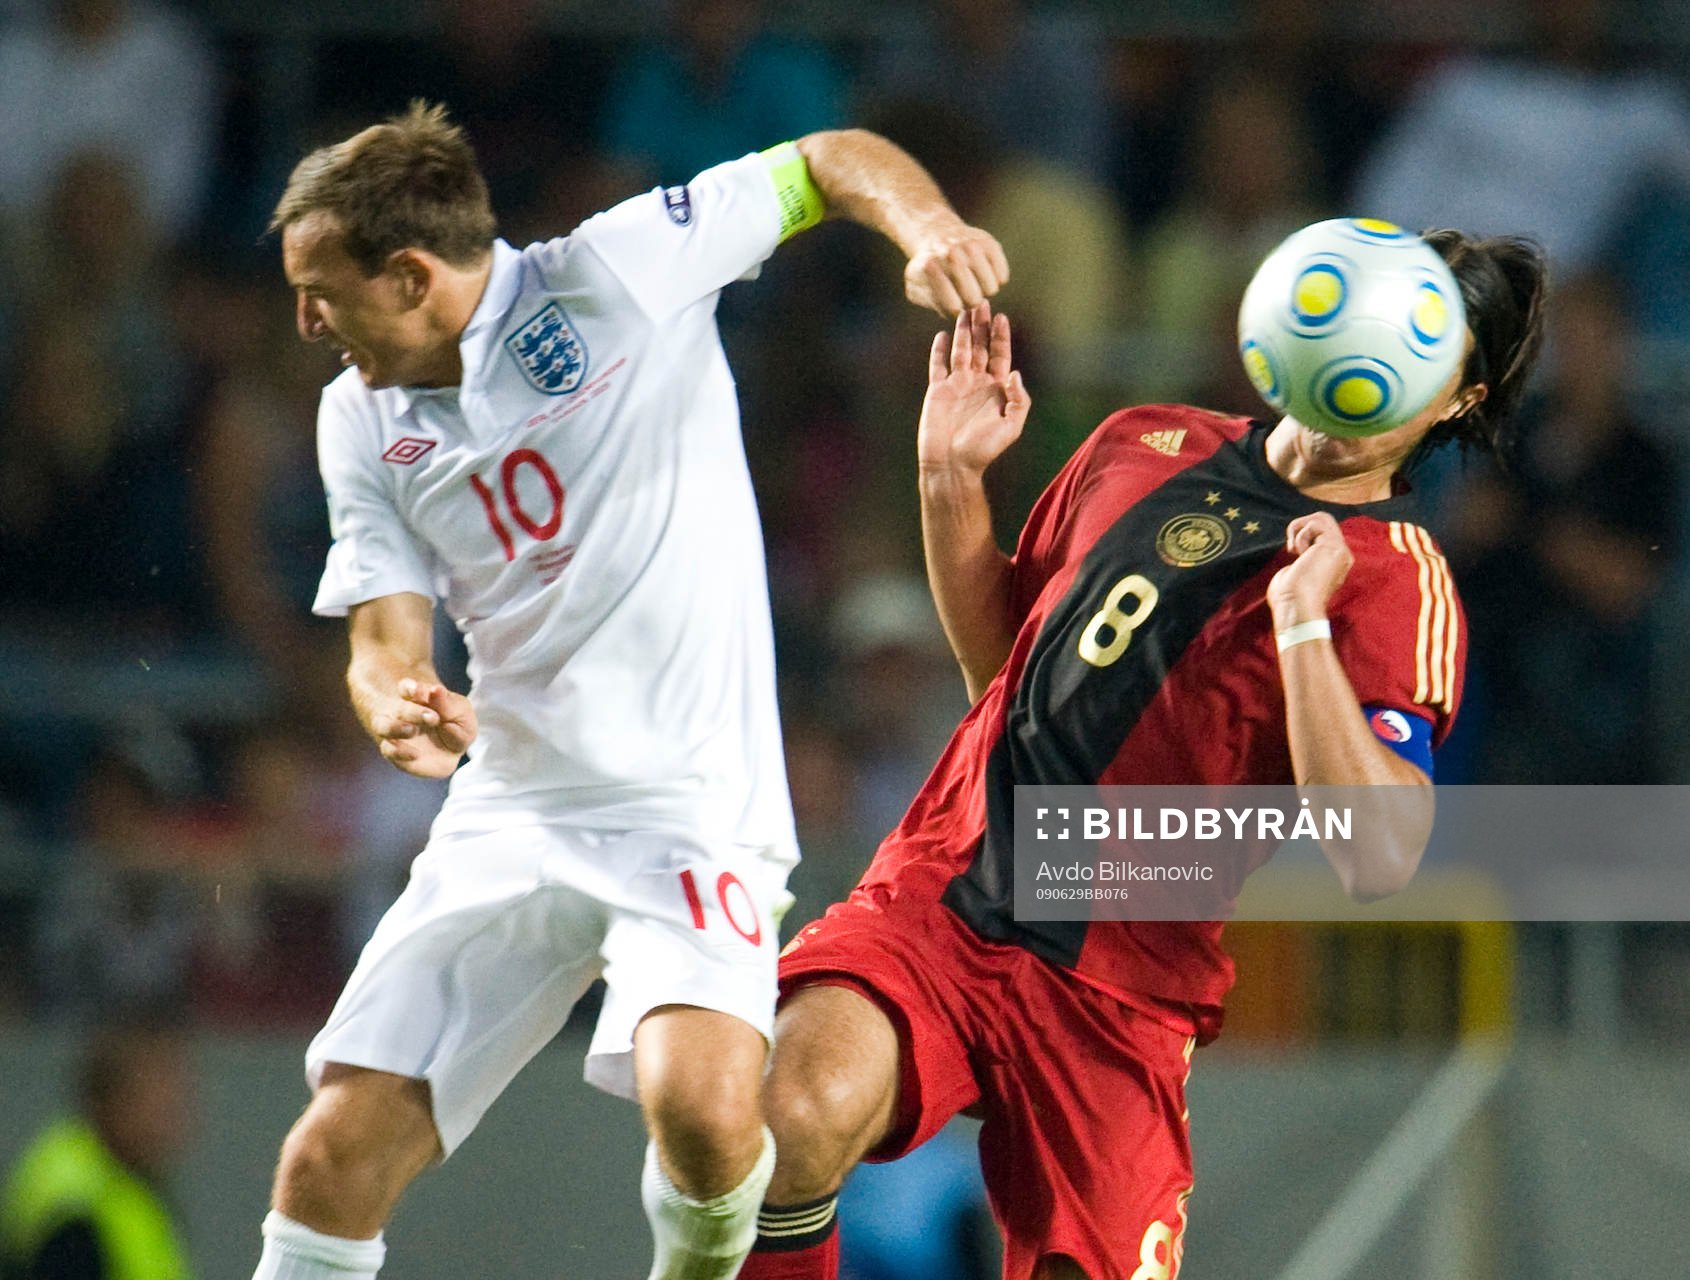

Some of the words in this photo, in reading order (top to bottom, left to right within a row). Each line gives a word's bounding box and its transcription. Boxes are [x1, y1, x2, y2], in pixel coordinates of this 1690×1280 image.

[469, 448, 566, 562] 10
[1078, 574, 1159, 667] 8
[679, 869, 761, 948] 10
